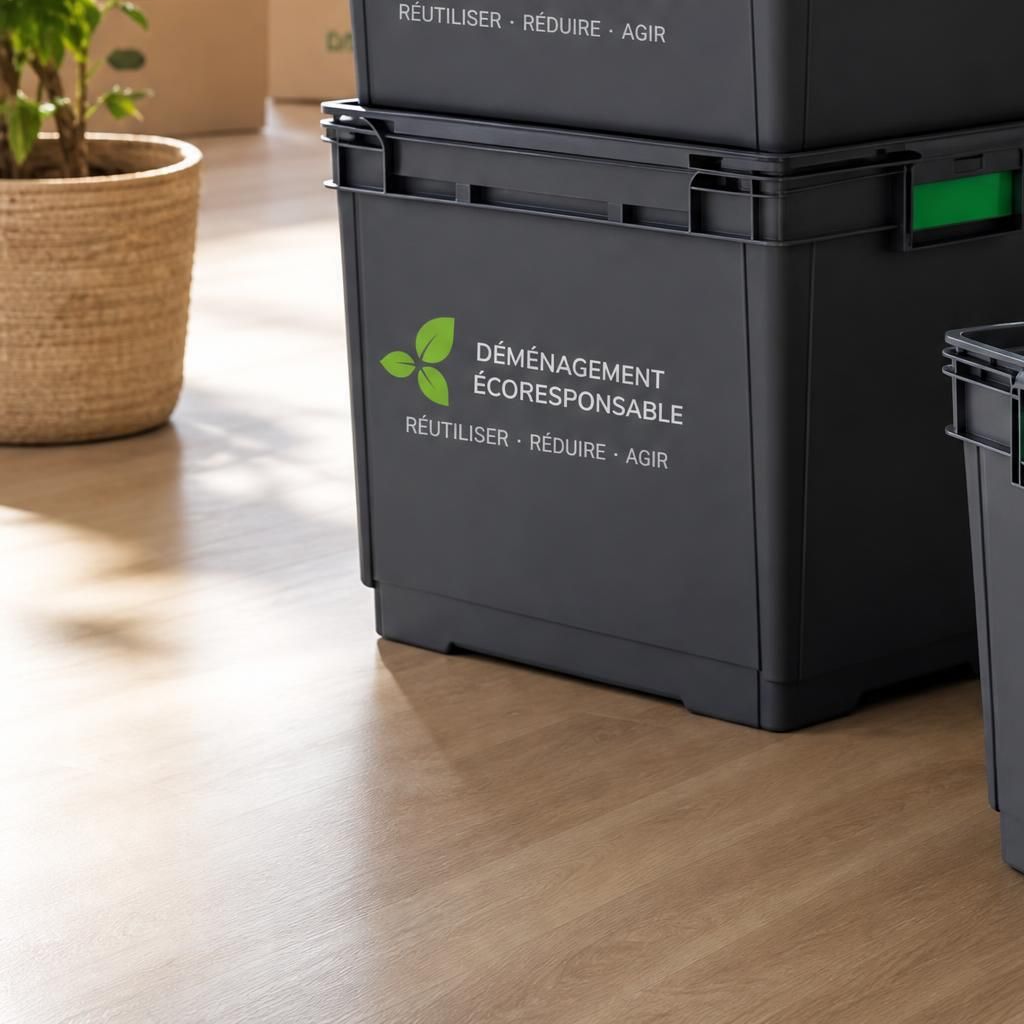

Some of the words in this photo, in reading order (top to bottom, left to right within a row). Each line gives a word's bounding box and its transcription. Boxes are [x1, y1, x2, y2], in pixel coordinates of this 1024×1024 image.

[399, 0, 502, 29] RÉUTILISER
[523, 11, 601, 38] RÉDUIRE
[621, 22, 666, 44] AGIR
[476, 340, 666, 390] DÉMÉNAGEMENT
[473, 370, 684, 426] ÉCORESPONSABLE
[405, 414, 509, 448] RÉUTILISER
[529, 432, 607, 461] RÉDUIRE
[625, 447, 669, 470] AGIR
